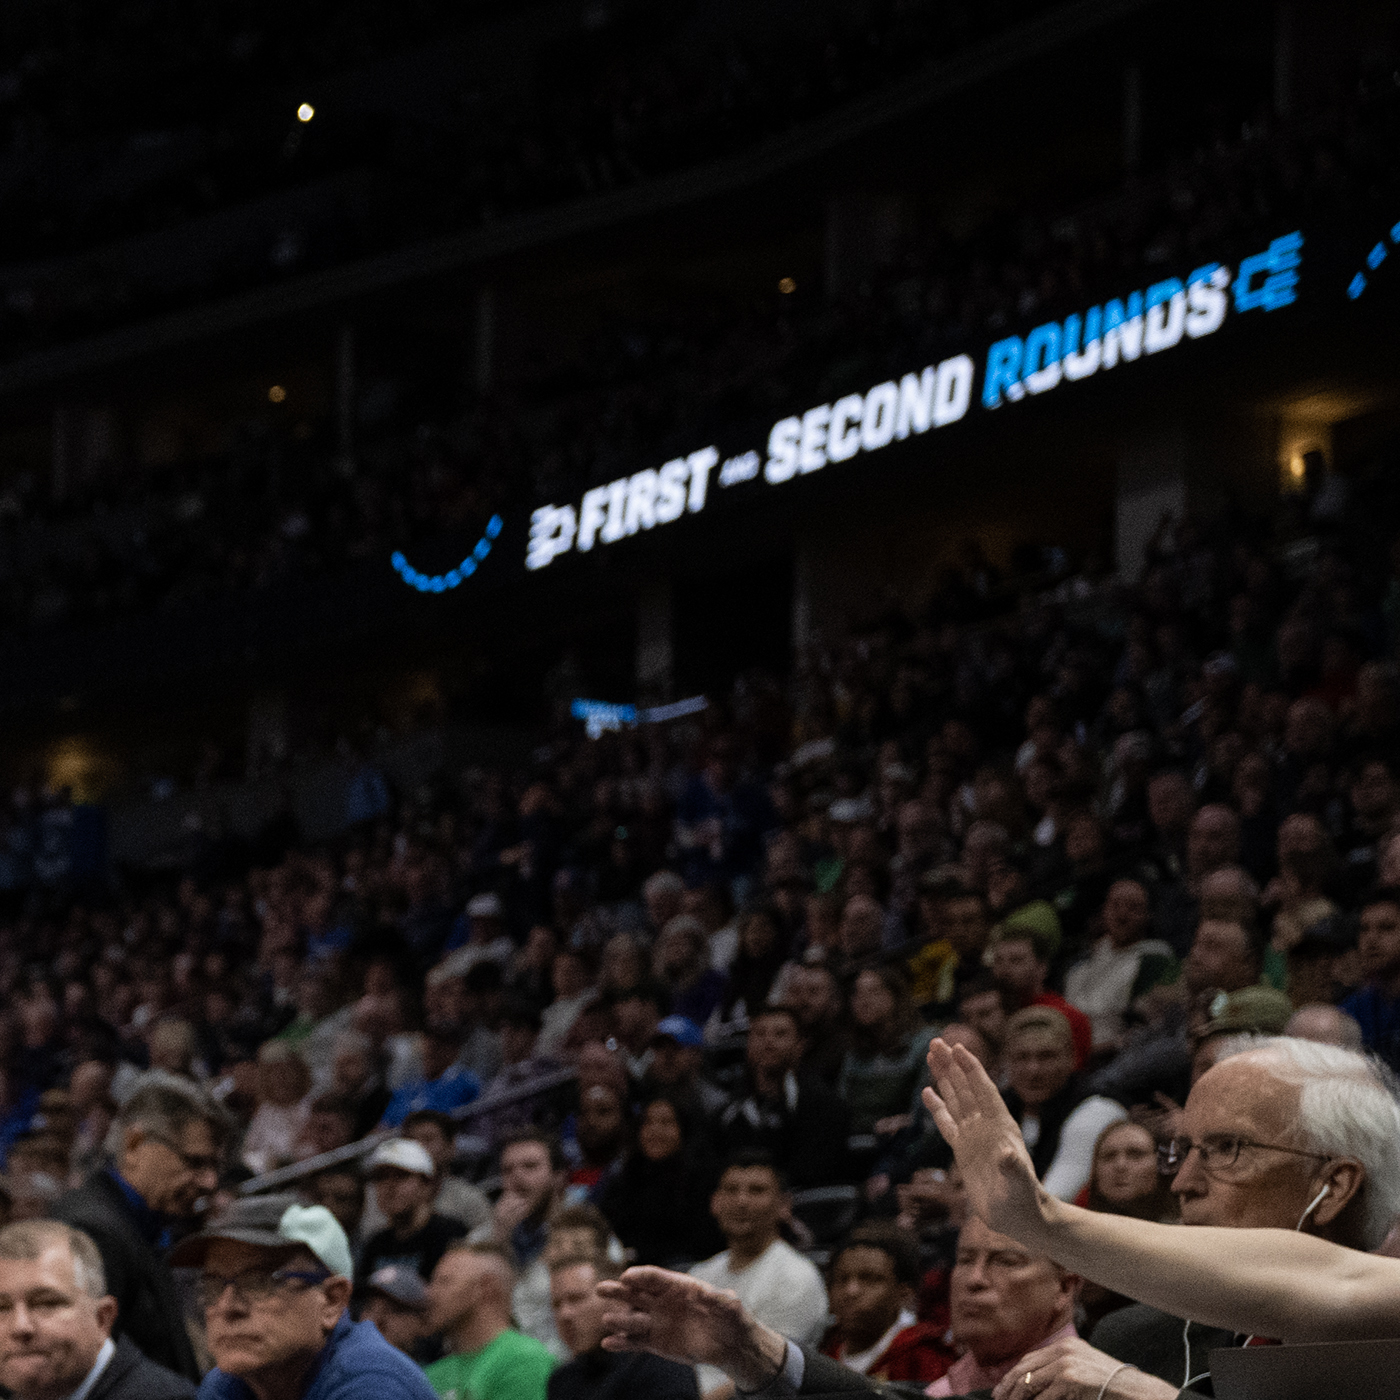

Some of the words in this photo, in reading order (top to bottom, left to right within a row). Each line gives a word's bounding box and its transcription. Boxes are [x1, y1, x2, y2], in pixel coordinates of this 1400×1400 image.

[577, 445, 719, 551] FIRST
[763, 353, 974, 485] SECOND
[983, 262, 1232, 408] ROUNDS
